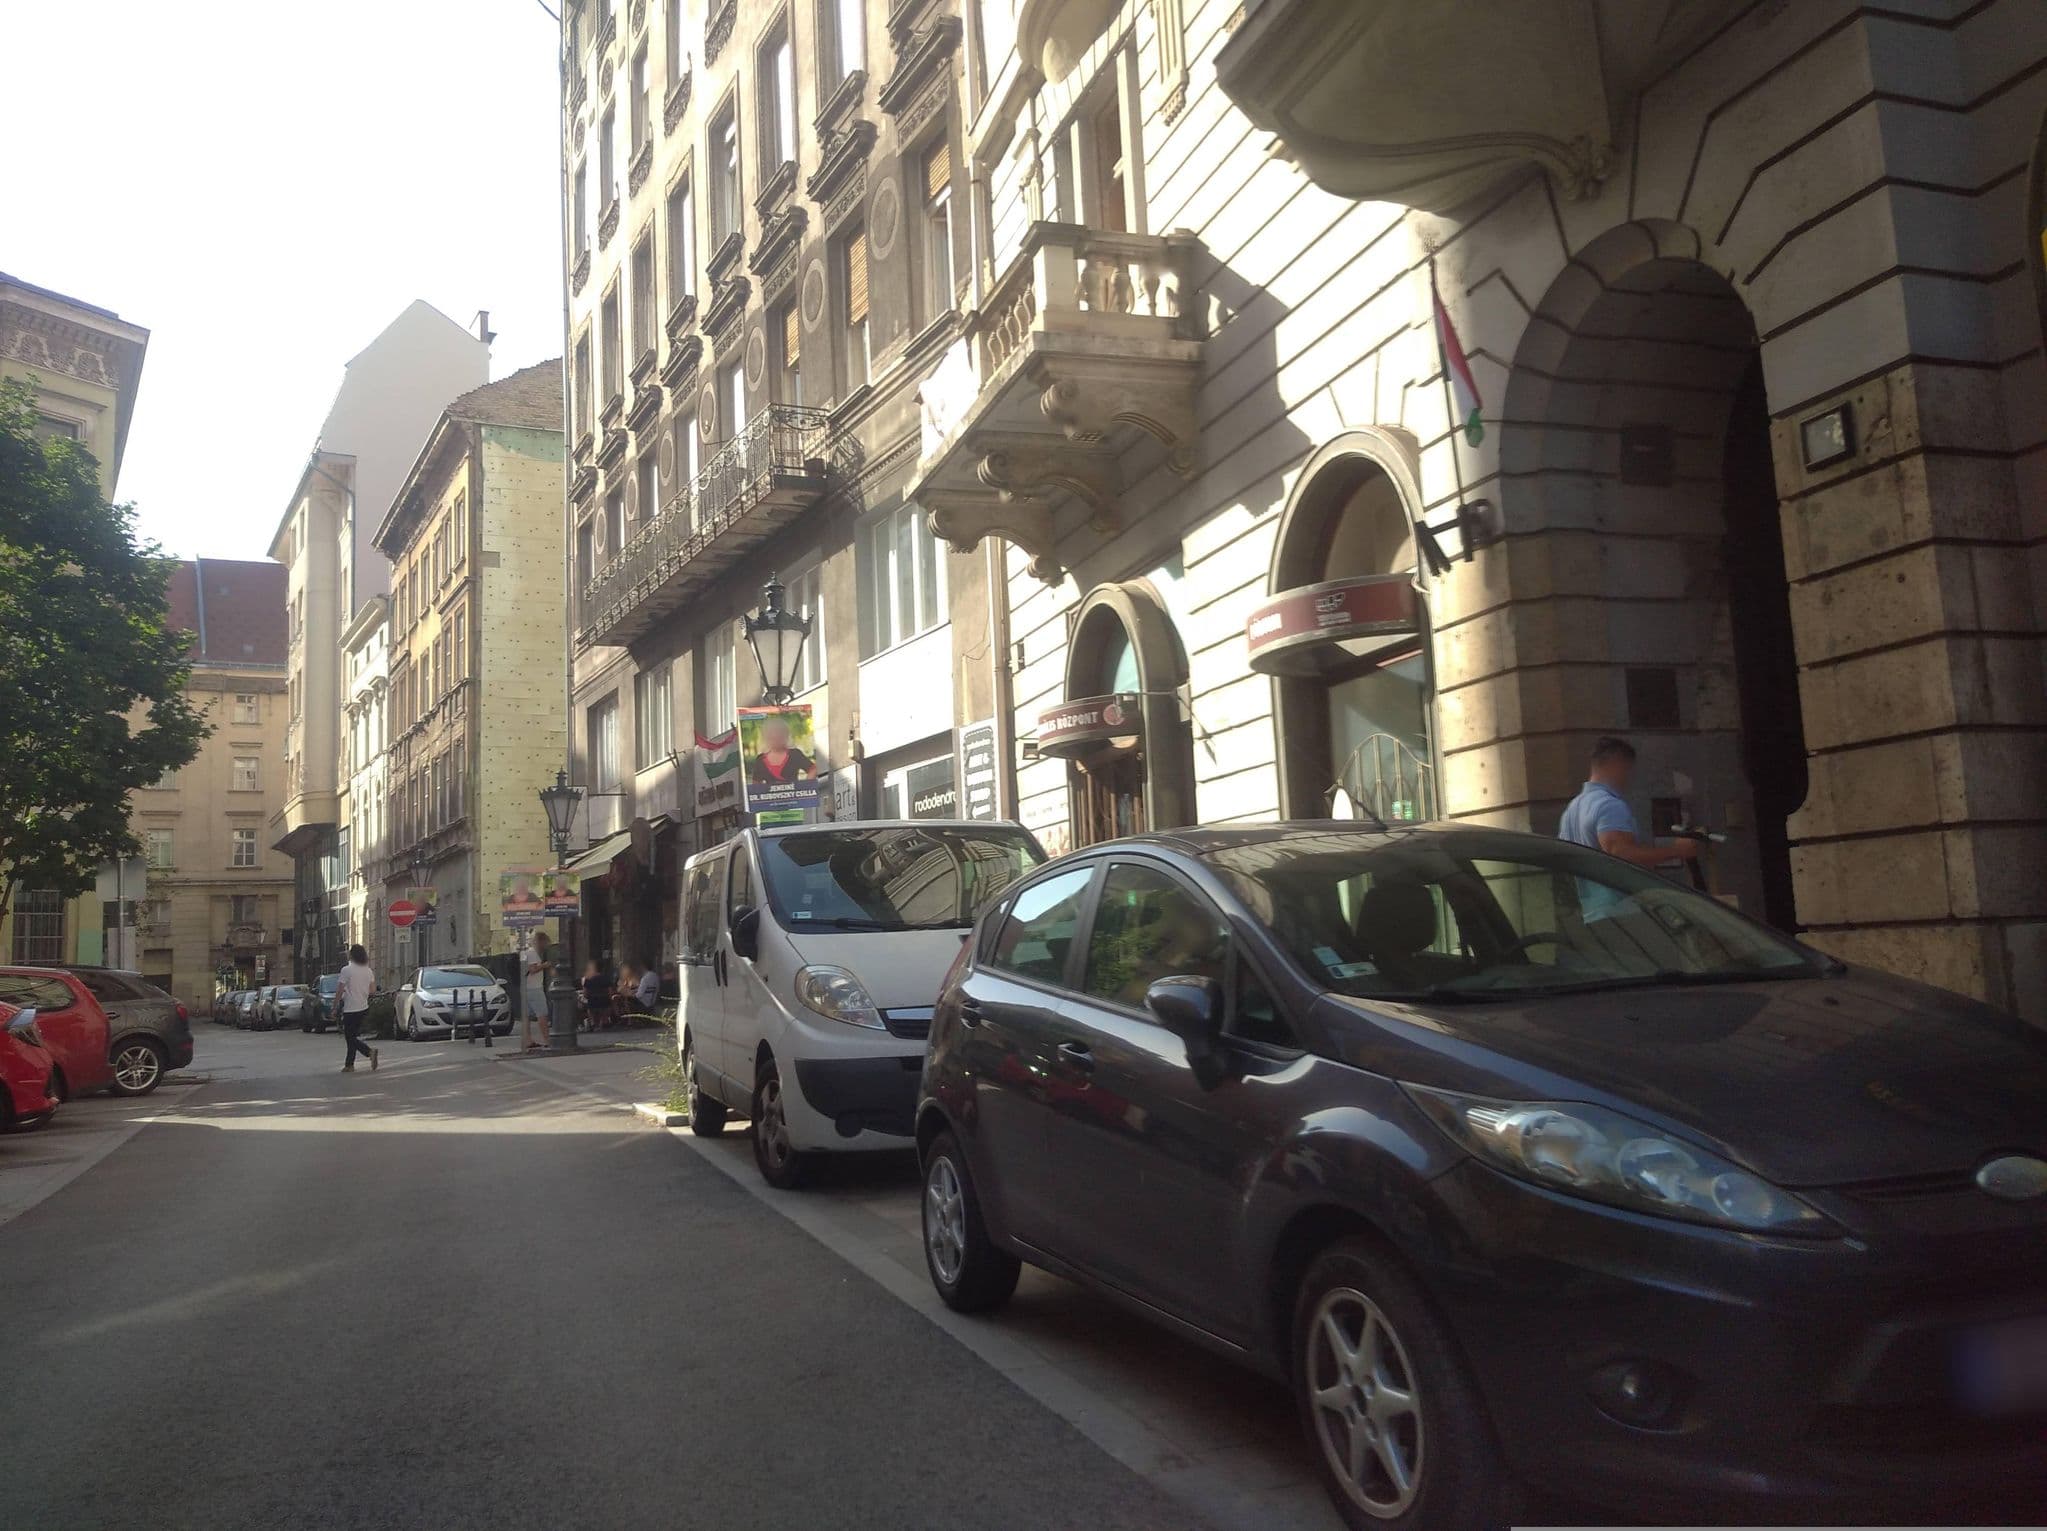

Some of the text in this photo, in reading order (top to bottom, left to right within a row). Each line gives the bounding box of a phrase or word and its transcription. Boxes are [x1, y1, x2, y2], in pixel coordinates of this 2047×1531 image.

[1056, 711, 1098, 730] KÖZPONT
[795, 789, 817, 798] CSILLA
[836, 788, 851, 810] art
